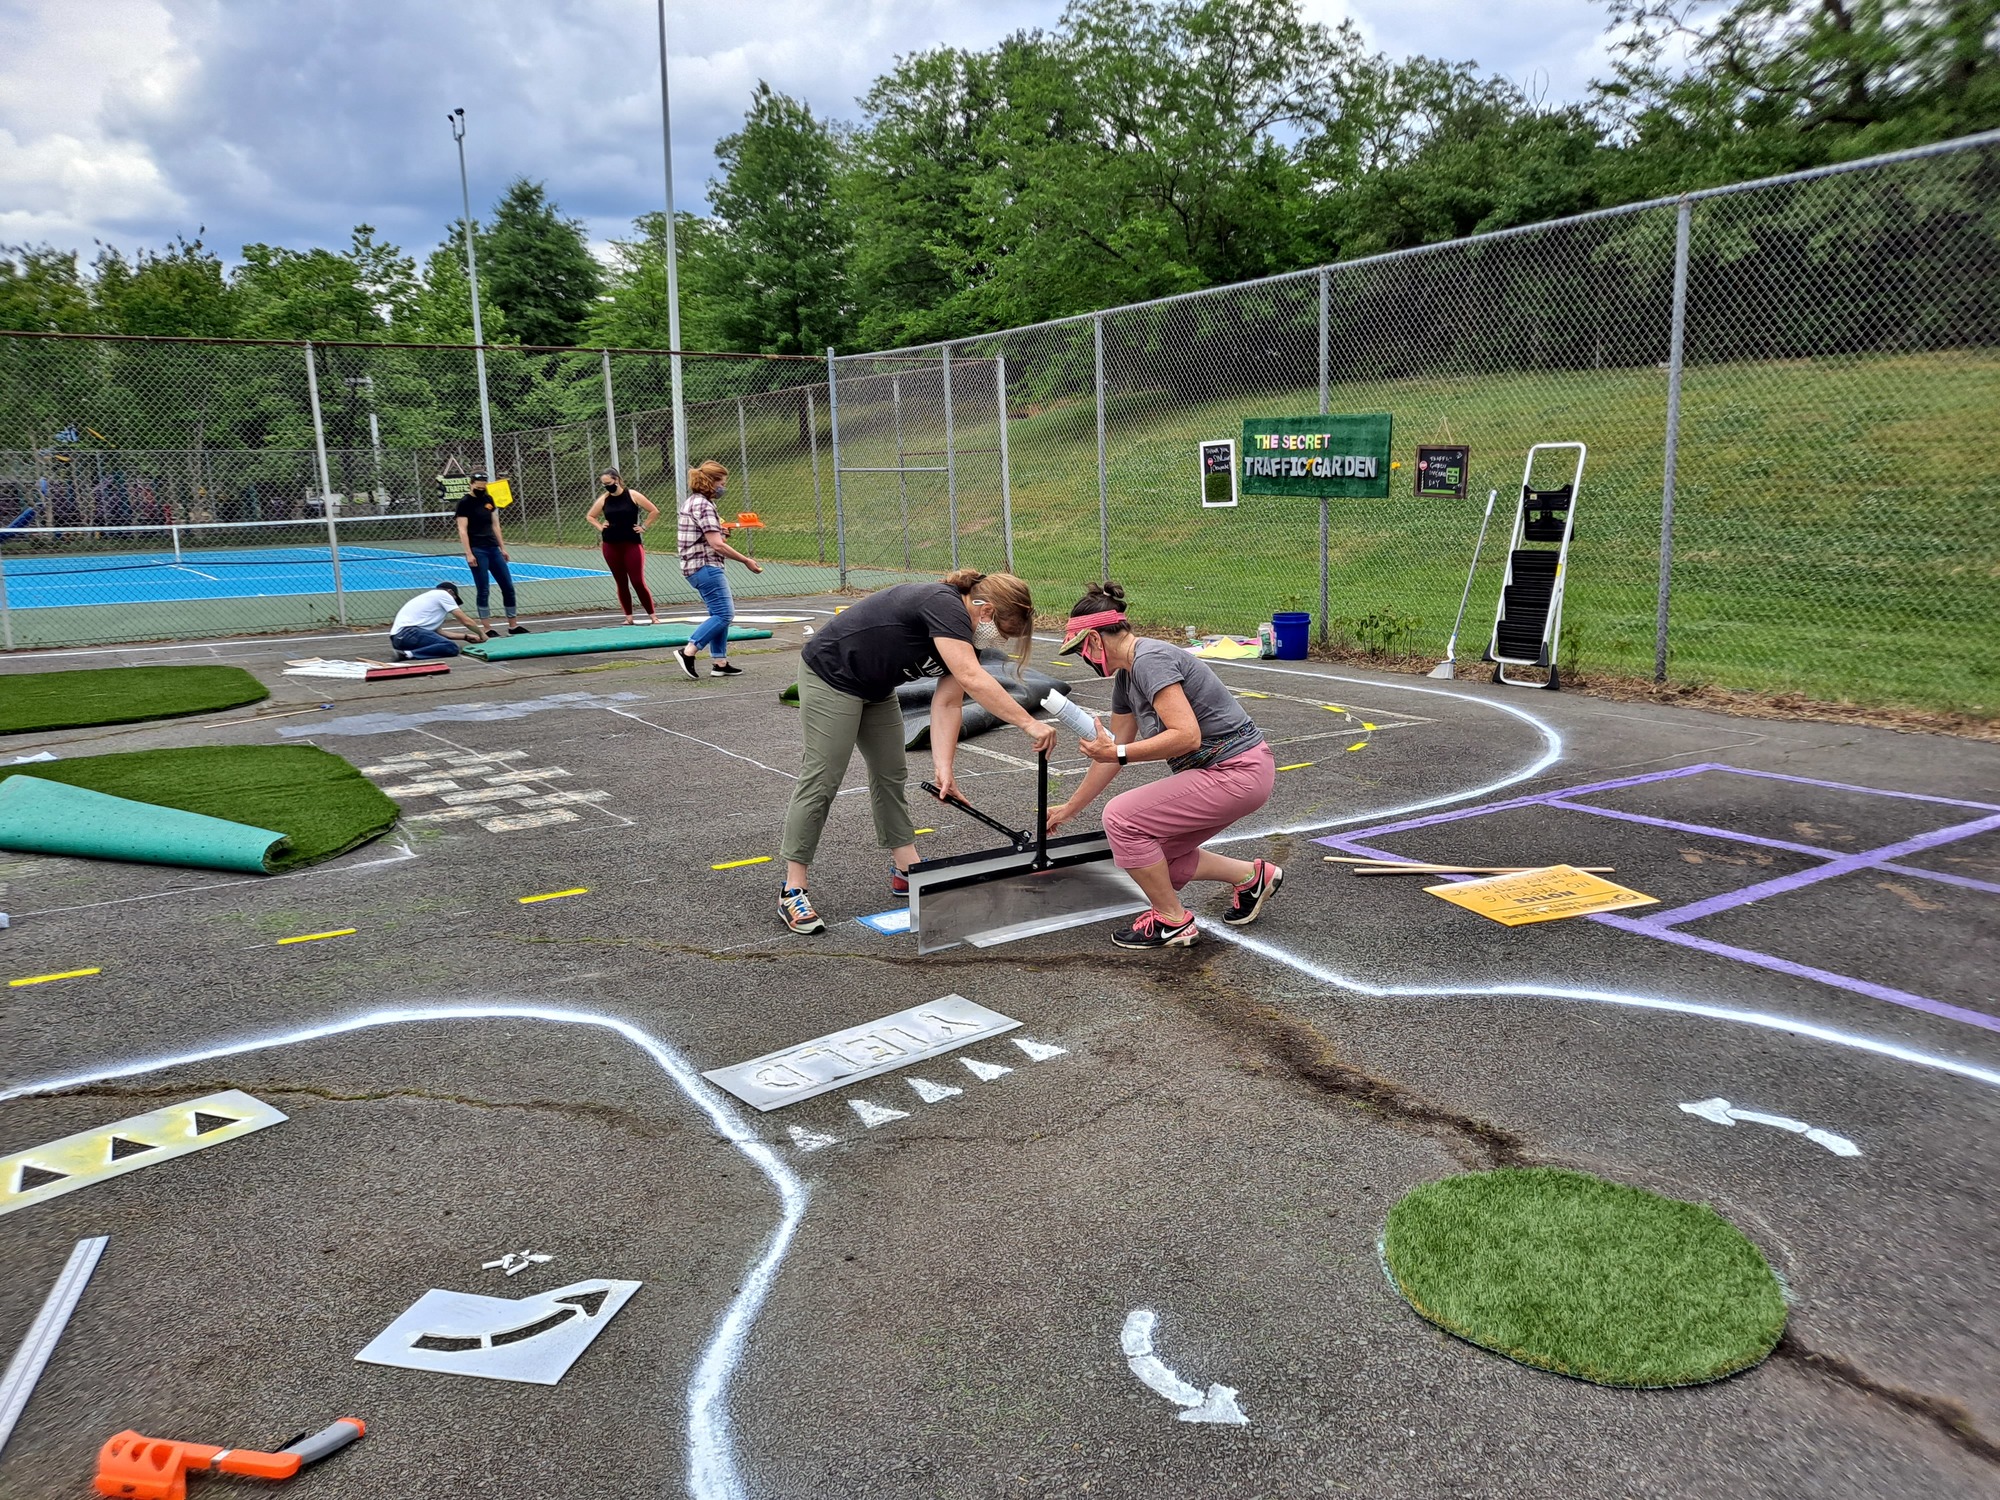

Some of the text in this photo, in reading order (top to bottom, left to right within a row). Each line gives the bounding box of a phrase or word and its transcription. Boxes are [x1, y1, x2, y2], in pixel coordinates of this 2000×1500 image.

[1254, 434, 1331, 450] THE SECRET
[1244, 456, 1379, 478] TRAFFIC GARDEN
[1482, 880, 1591, 903] NO PARKING
[1513, 890, 1578, 904] NOTICE
[756, 1011, 984, 1090] YIELD
